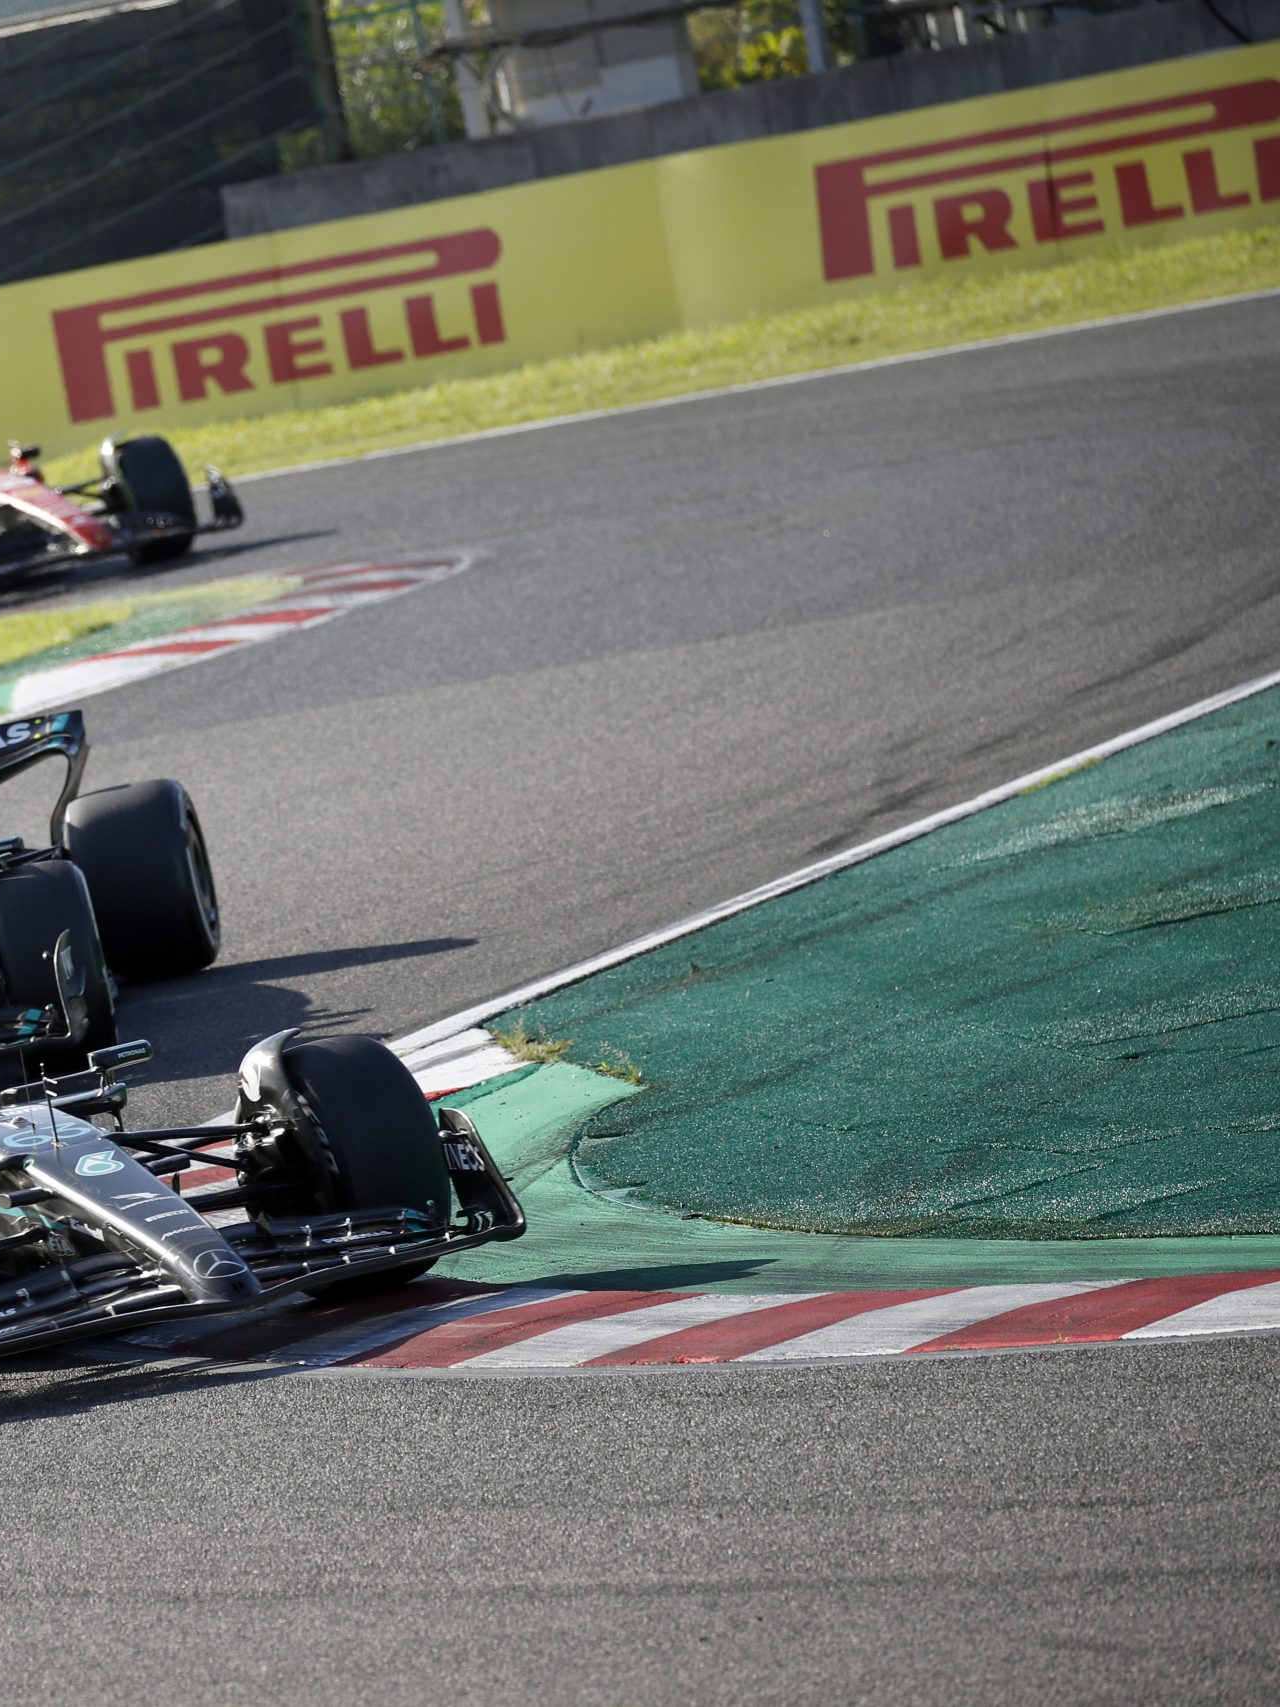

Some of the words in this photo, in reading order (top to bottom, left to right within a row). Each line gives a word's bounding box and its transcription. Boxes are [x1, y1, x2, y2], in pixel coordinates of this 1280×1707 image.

[815, 78, 1280, 282] PIRELLI
[51, 227, 507, 424] PIRELLI
[3, 1122, 93, 1148] 63
